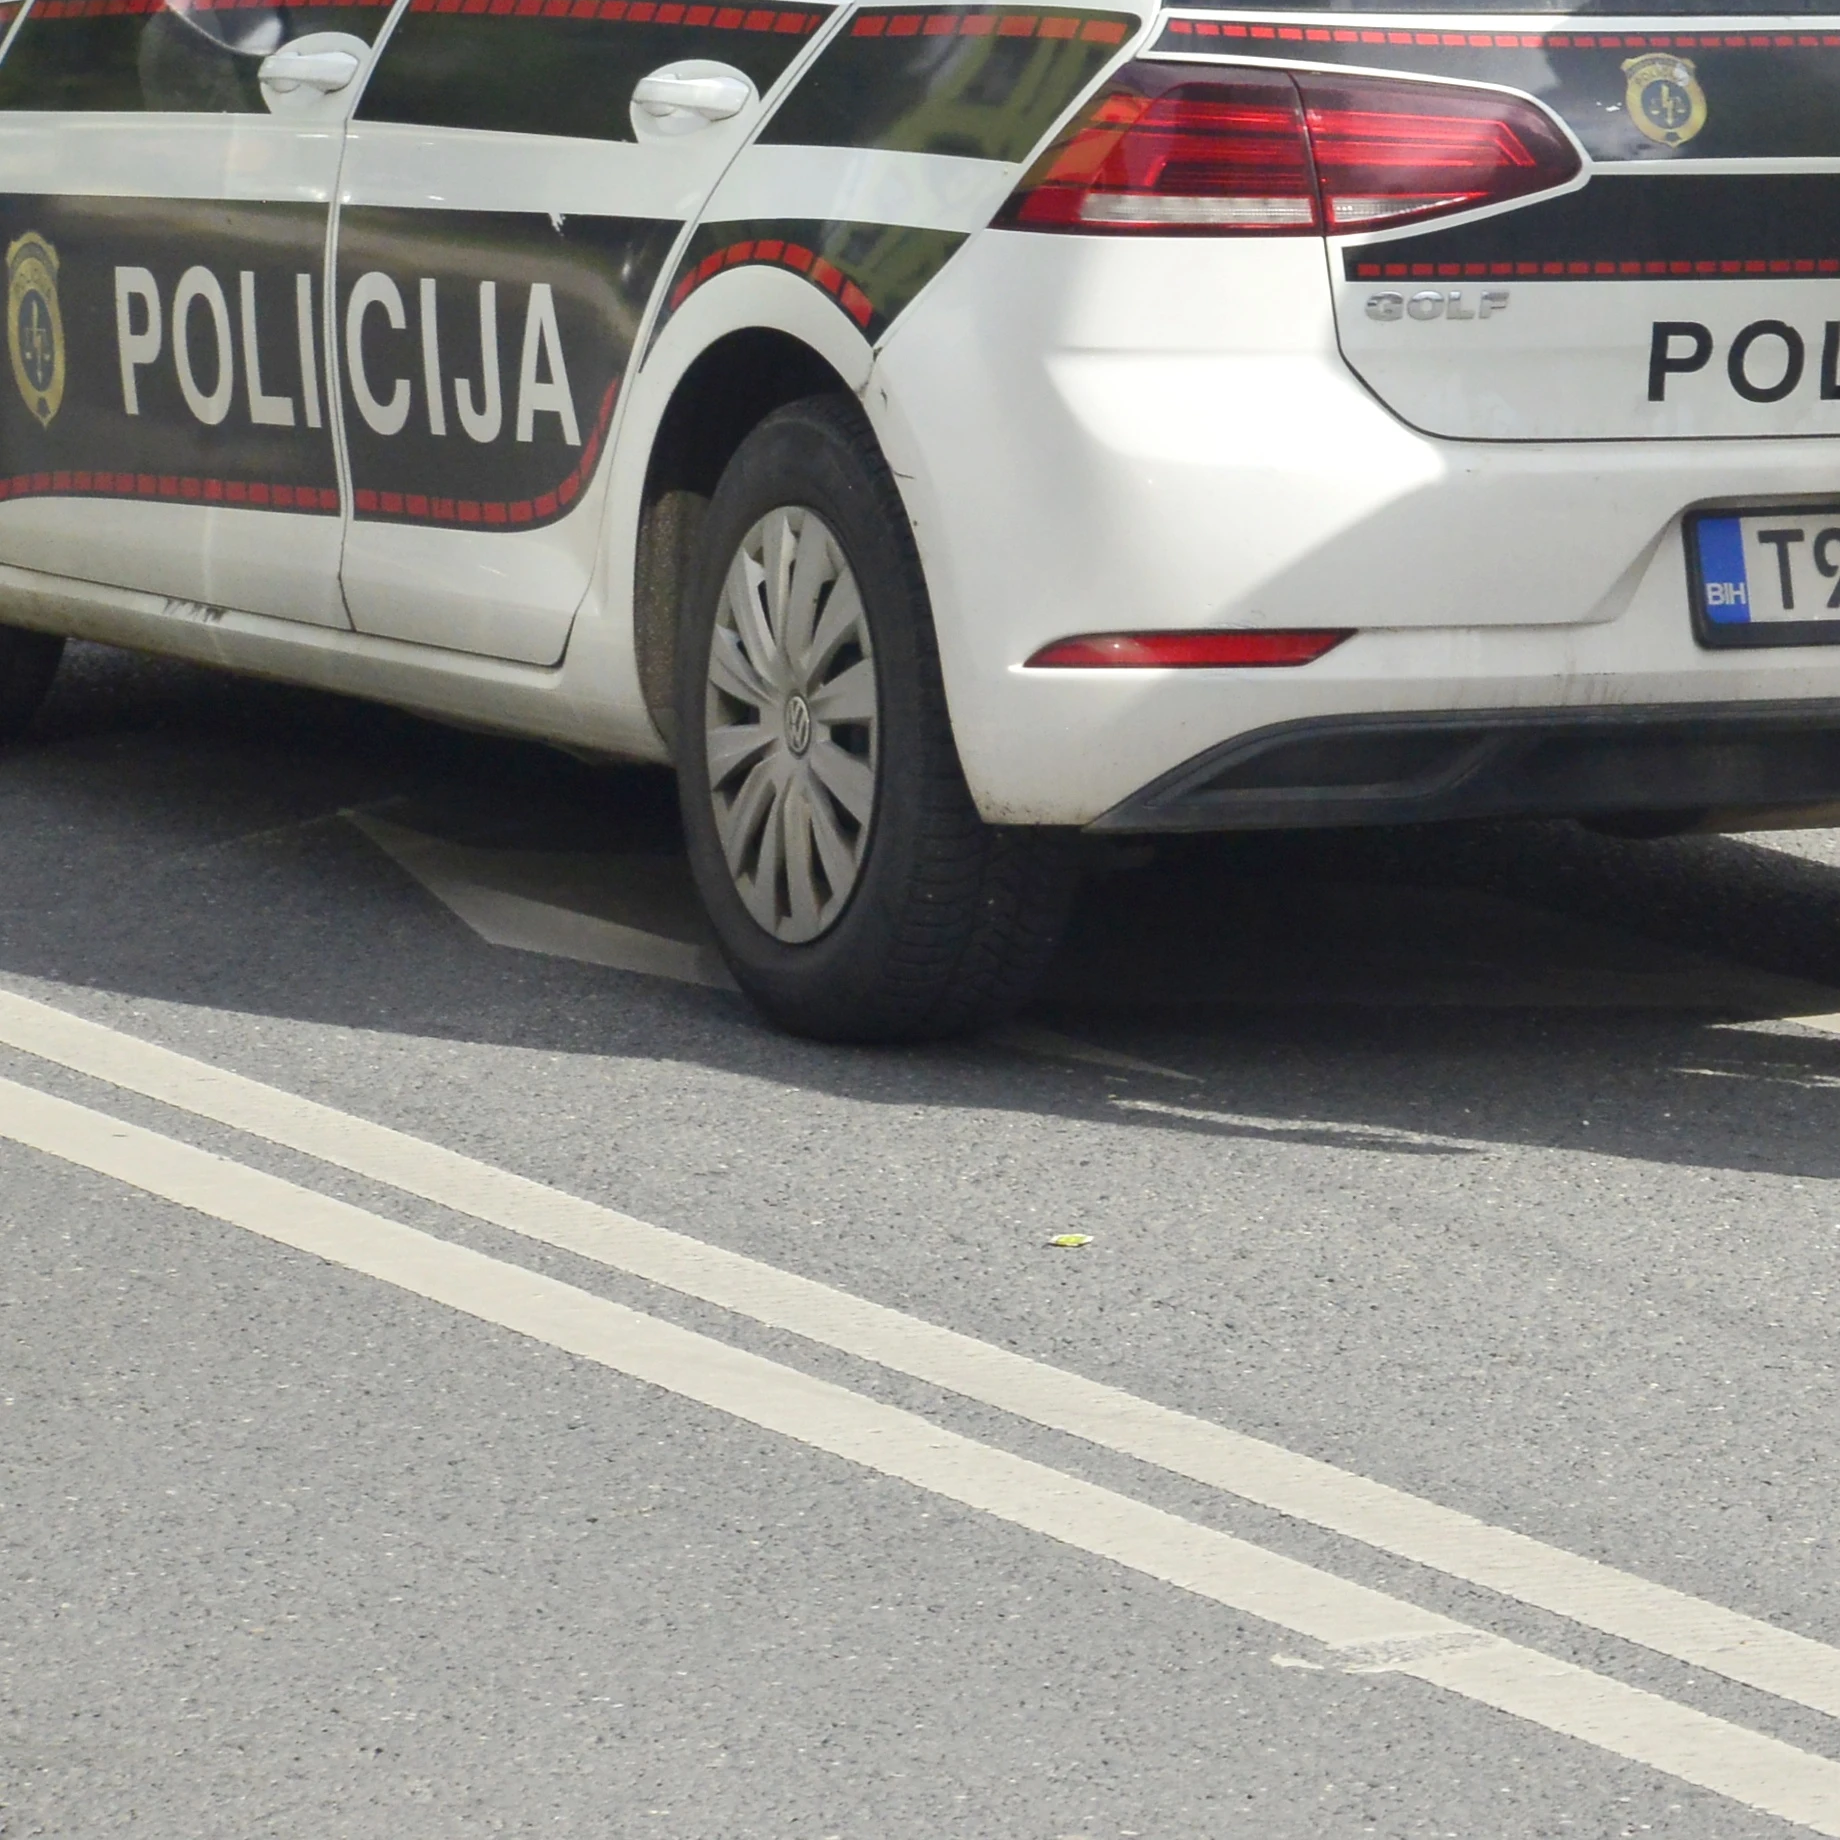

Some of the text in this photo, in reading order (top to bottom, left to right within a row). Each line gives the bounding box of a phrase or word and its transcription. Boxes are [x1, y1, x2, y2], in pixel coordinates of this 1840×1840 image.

[1364, 290, 1511, 322] GOLF
[115, 265, 581, 446] POLICIJA
[1706, 582, 1747, 606] BIH
